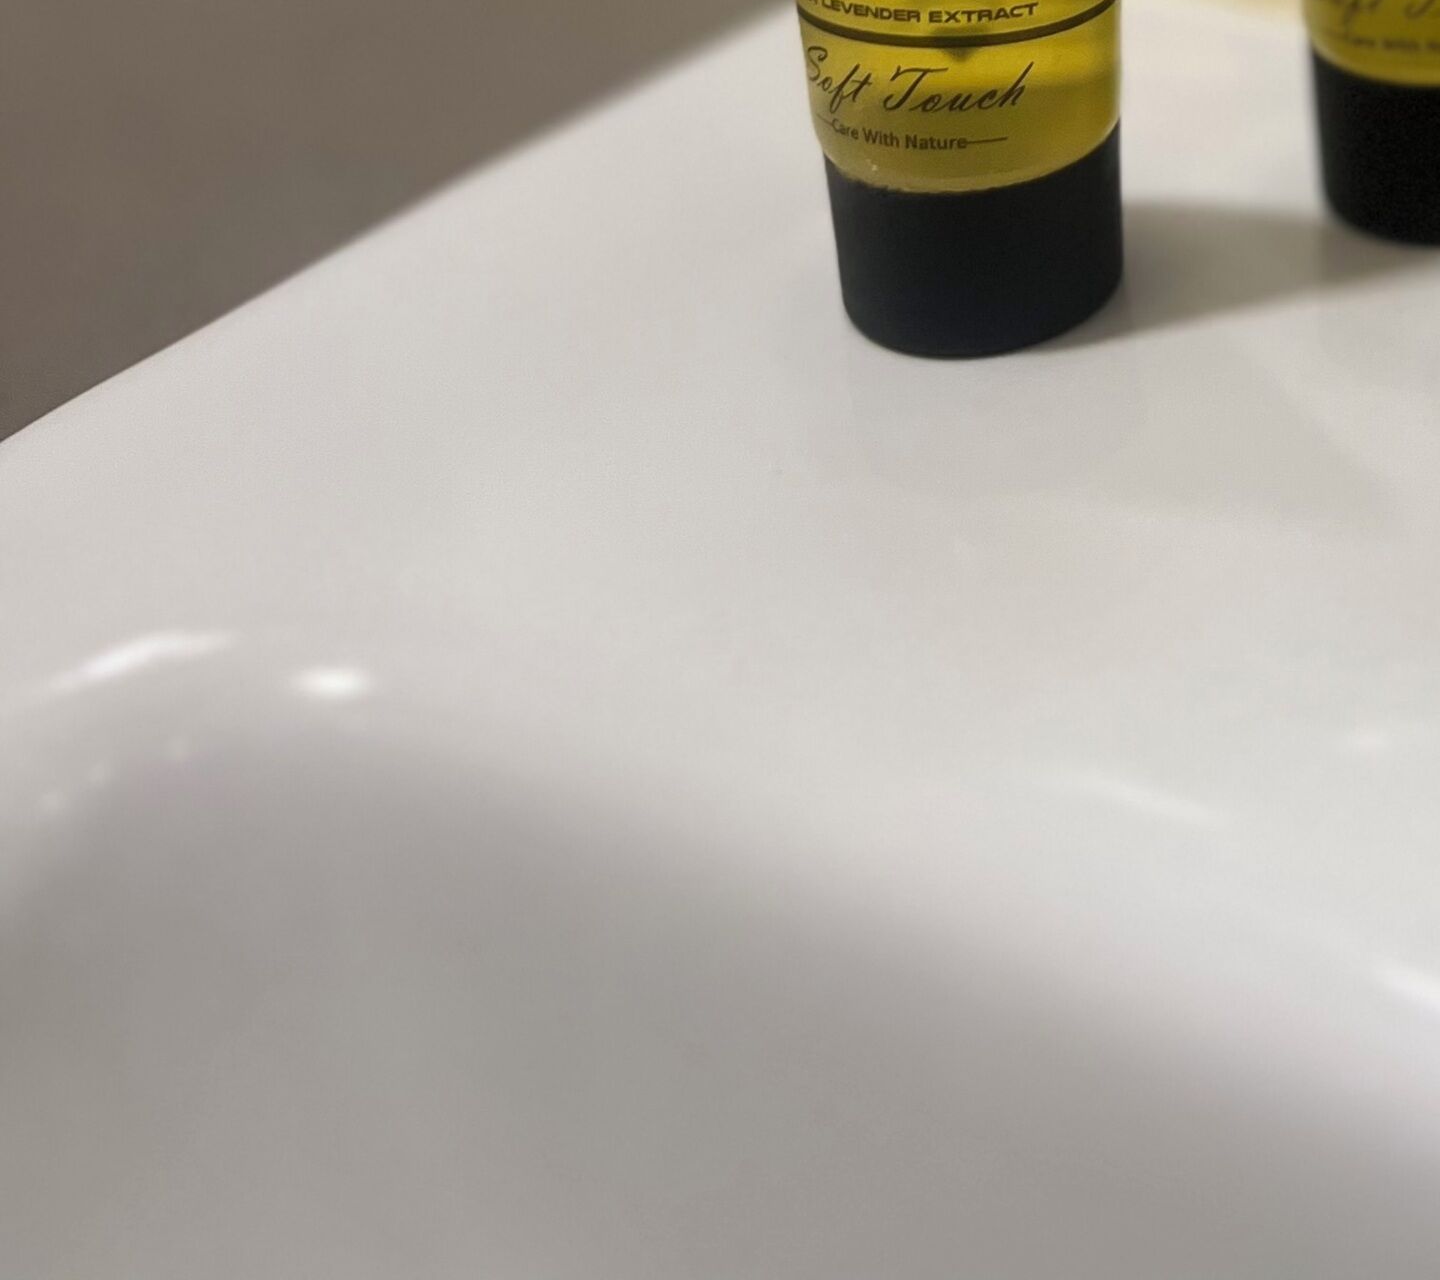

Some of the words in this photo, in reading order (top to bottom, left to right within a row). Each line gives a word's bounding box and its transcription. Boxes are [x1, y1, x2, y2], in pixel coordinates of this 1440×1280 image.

[928, 1, 1040, 24] EXTRACT
[806, 45, 874, 114] Soft
[882, 60, 1036, 113] Touch
[861, 126, 901, 149] With
[904, 133, 969, 151] Nature
